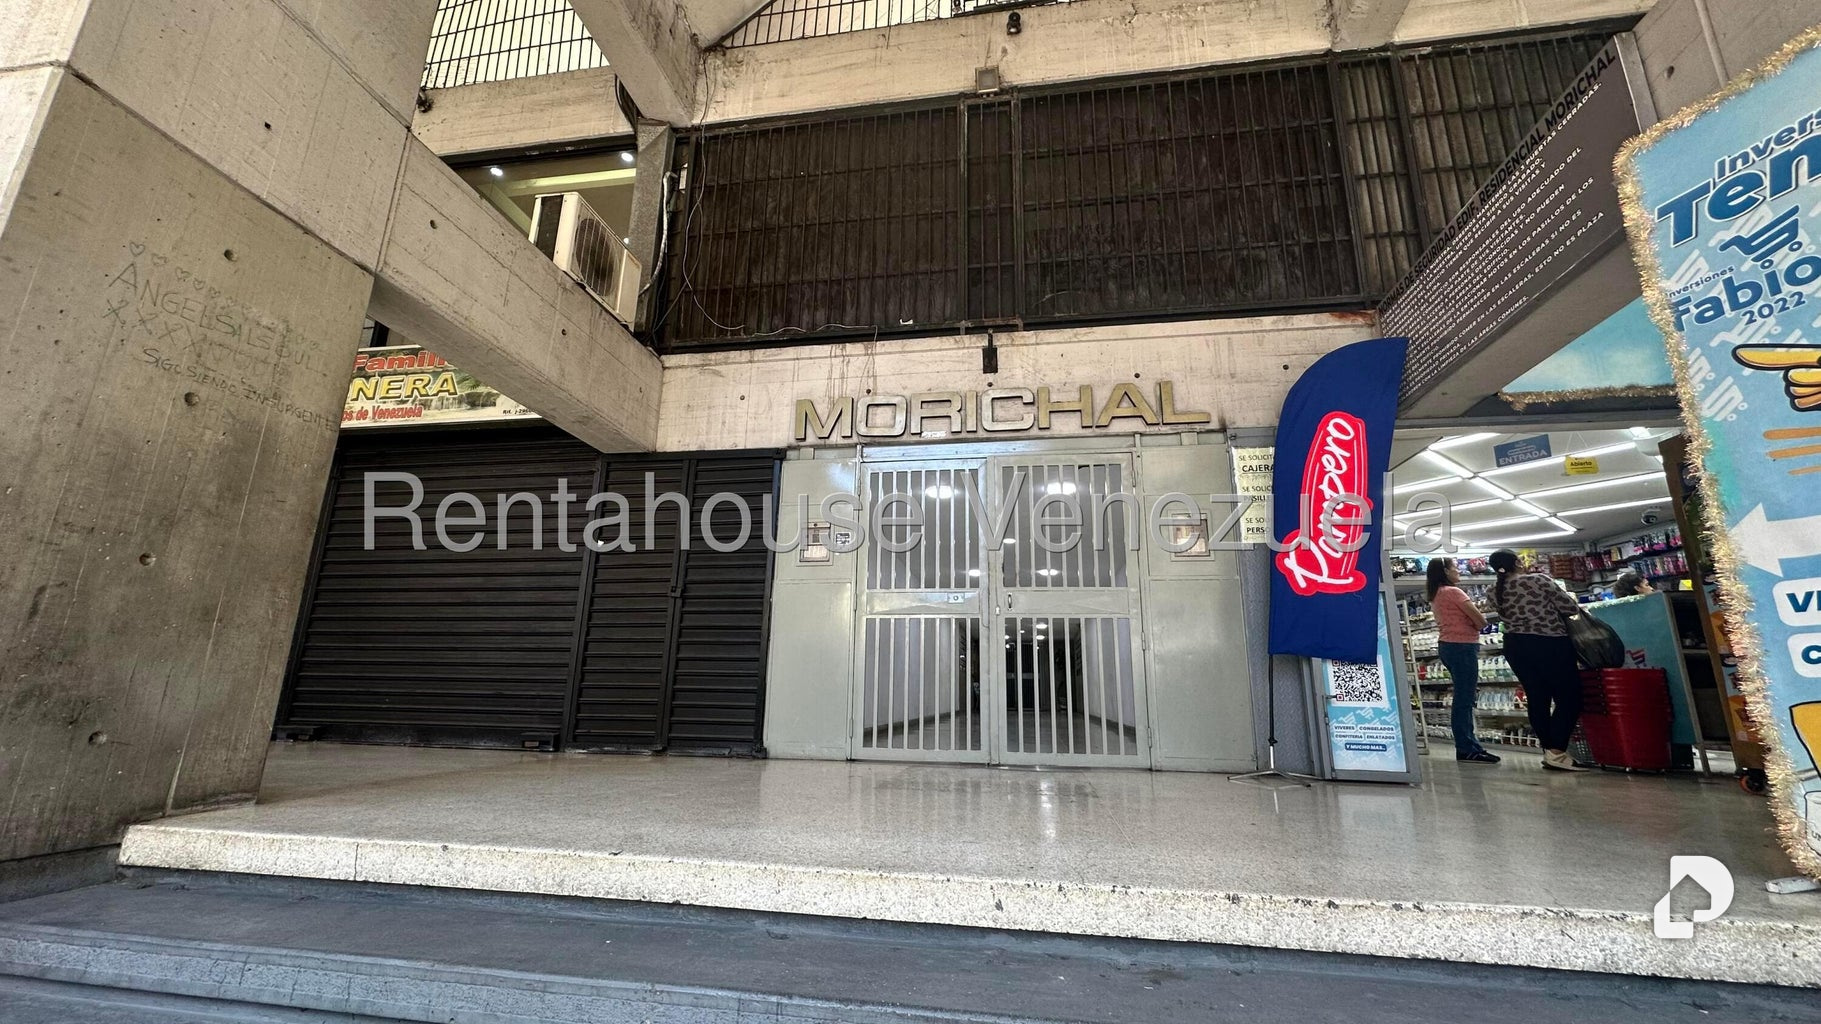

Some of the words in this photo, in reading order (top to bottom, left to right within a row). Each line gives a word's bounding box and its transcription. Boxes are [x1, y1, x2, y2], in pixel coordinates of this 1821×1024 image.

[1378, 282, 1404, 314] NORMAS
[1415, 226, 1455, 277] SEGURIDAD
[1456, 201, 1478, 230] EDIF.
[1479, 128, 1545, 206] RESIDENCIAL
[1545, 50, 1615, 132] MORICHAL
[1477, 185, 1506, 218] MANTENER
[1526, 131, 1556, 165] PUERTAS
[1558, 84, 1601, 130] CERRADAS.
[1449, 272, 1474, 298] PERSONAS
[1475, 229, 1518, 273] DESCONOCIDAS
[1537, 184, 1564, 213] PUEDEN
[1456, 232, 1471, 249] USTED
[1487, 193, 1507, 216] SIENDO
[1509, 158, 1542, 192] GRABADO.
[1460, 230, 1499, 272] RESPONSABLES
[1513, 203, 1525, 217] USO
[1528, 163, 1565, 203] ADECUADO
[1567, 148, 1581, 162] DEL
[1475, 215, 1495, 238] RECIBIR
[1515, 169, 1540, 195] VISITAS
[1455, 268, 1470, 284] PARTE
[1490, 214, 1525, 248] VISITANTES.
[1456, 277, 1487, 308] ESTACIONAR
[1488, 258, 1508, 278] MOTOS
[1519, 236, 1530, 249] LOS
[1532, 204, 1564, 237] PASILLOS
[1578, 177, 1593, 193] LOS
[1459, 321, 1476, 337] COMER
[1535, 256, 1552, 272] ESTO
[1577, 212, 1603, 236] PLAZA
[1484, 249, 1509, 273] EDIFICIO.
[1457, 292, 1490, 323] PERMANECER
[1513, 239, 1549, 273] ESCALERAS
[1498, 296, 1528, 322] COMUNES.
[1671, 256, 1821, 332] Fabio
[1742, 291, 1806, 326] 2022
[350, 372, 459, 401] NERA
[356, 407, 368, 420] de
[371, 403, 423, 419] Venezuela
[795, 380, 1211, 439] MORICHAL
[1500, 449, 1547, 465] ENTRADA
[1284, 418, 1354, 588] Pampero
